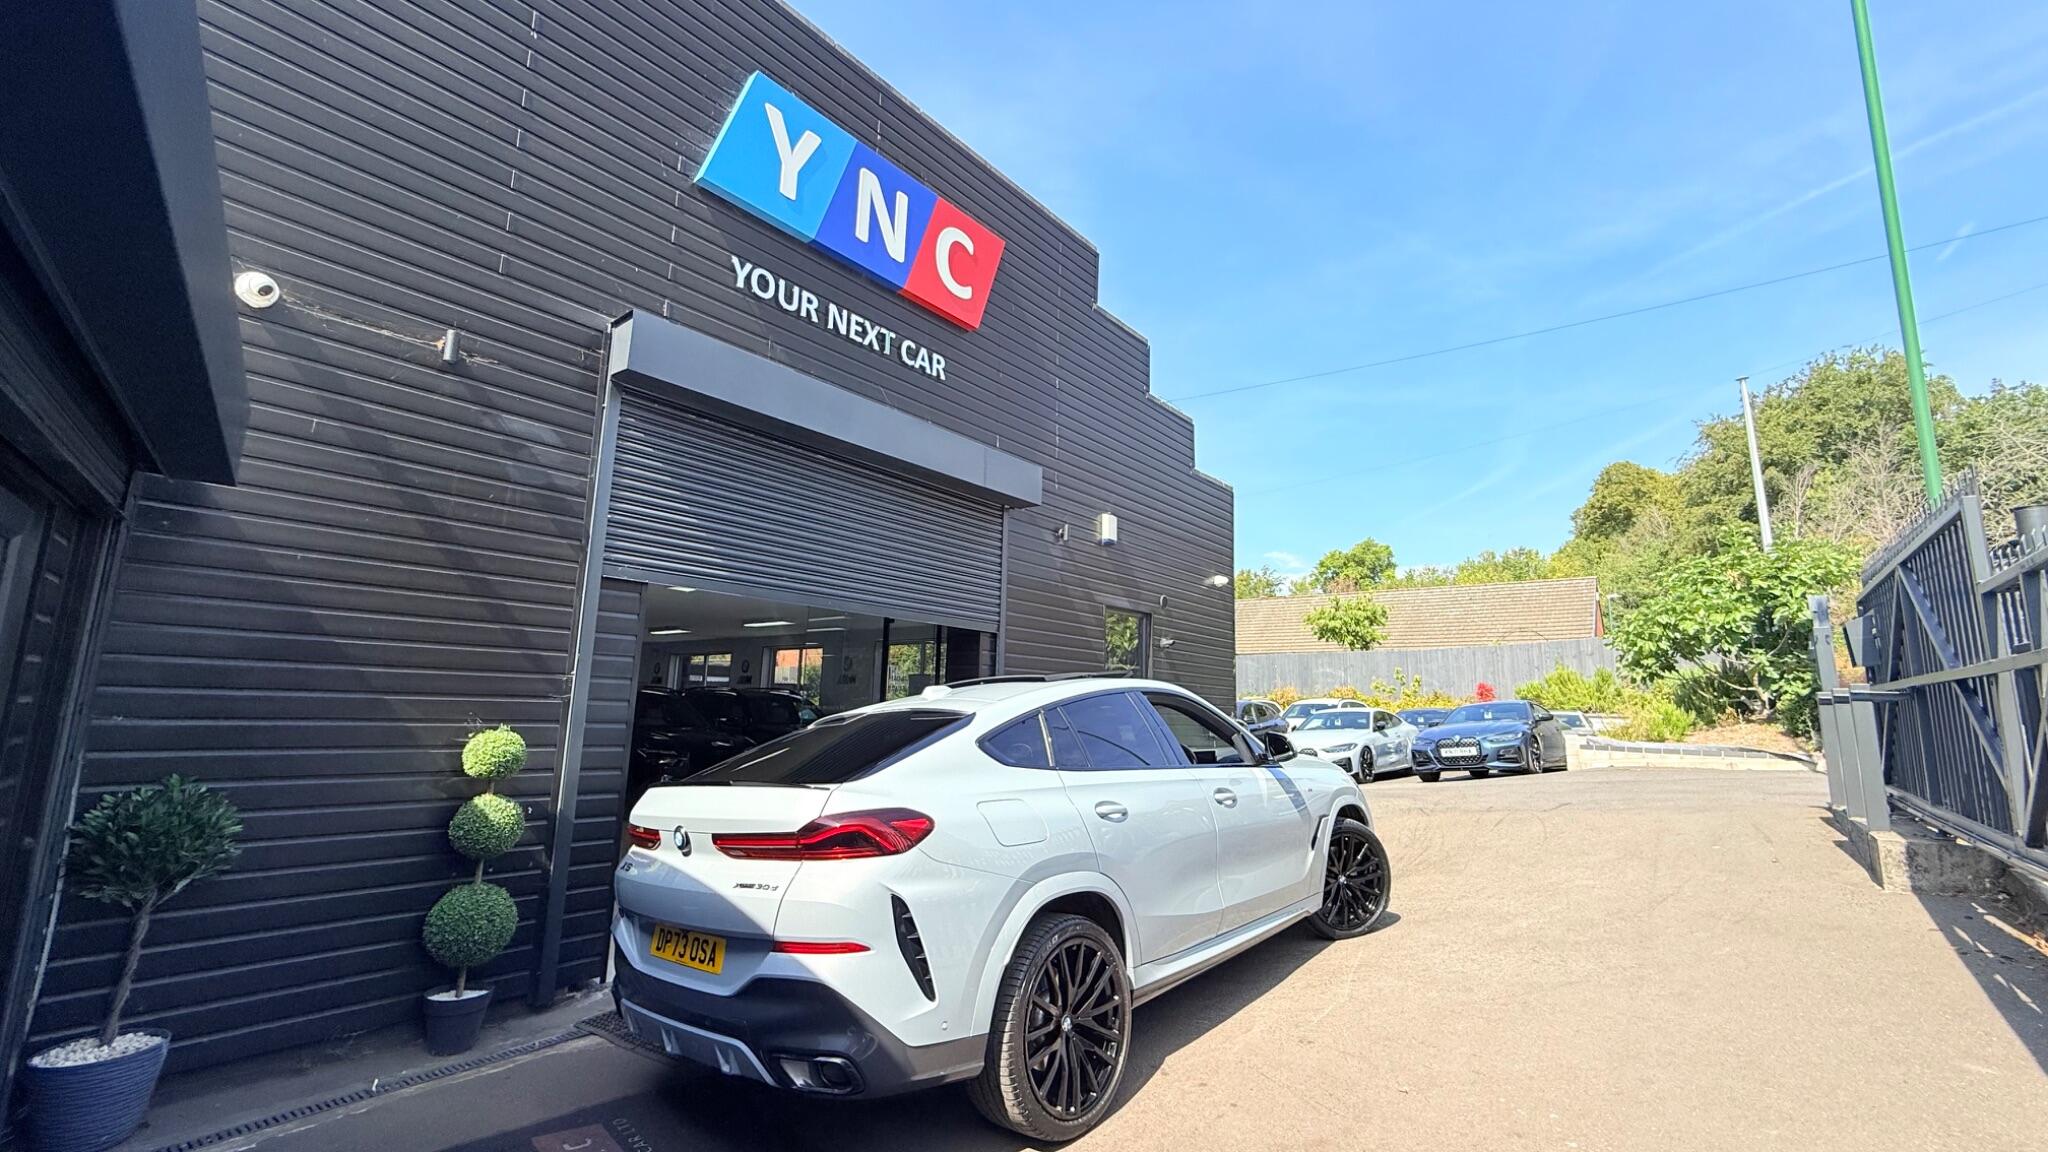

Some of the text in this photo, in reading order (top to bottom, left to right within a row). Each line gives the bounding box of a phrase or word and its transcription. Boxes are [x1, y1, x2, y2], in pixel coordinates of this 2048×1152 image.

[731, 256, 946, 380] YOUR NEXT CAR
[656, 927, 717, 967] DP73 OSA
